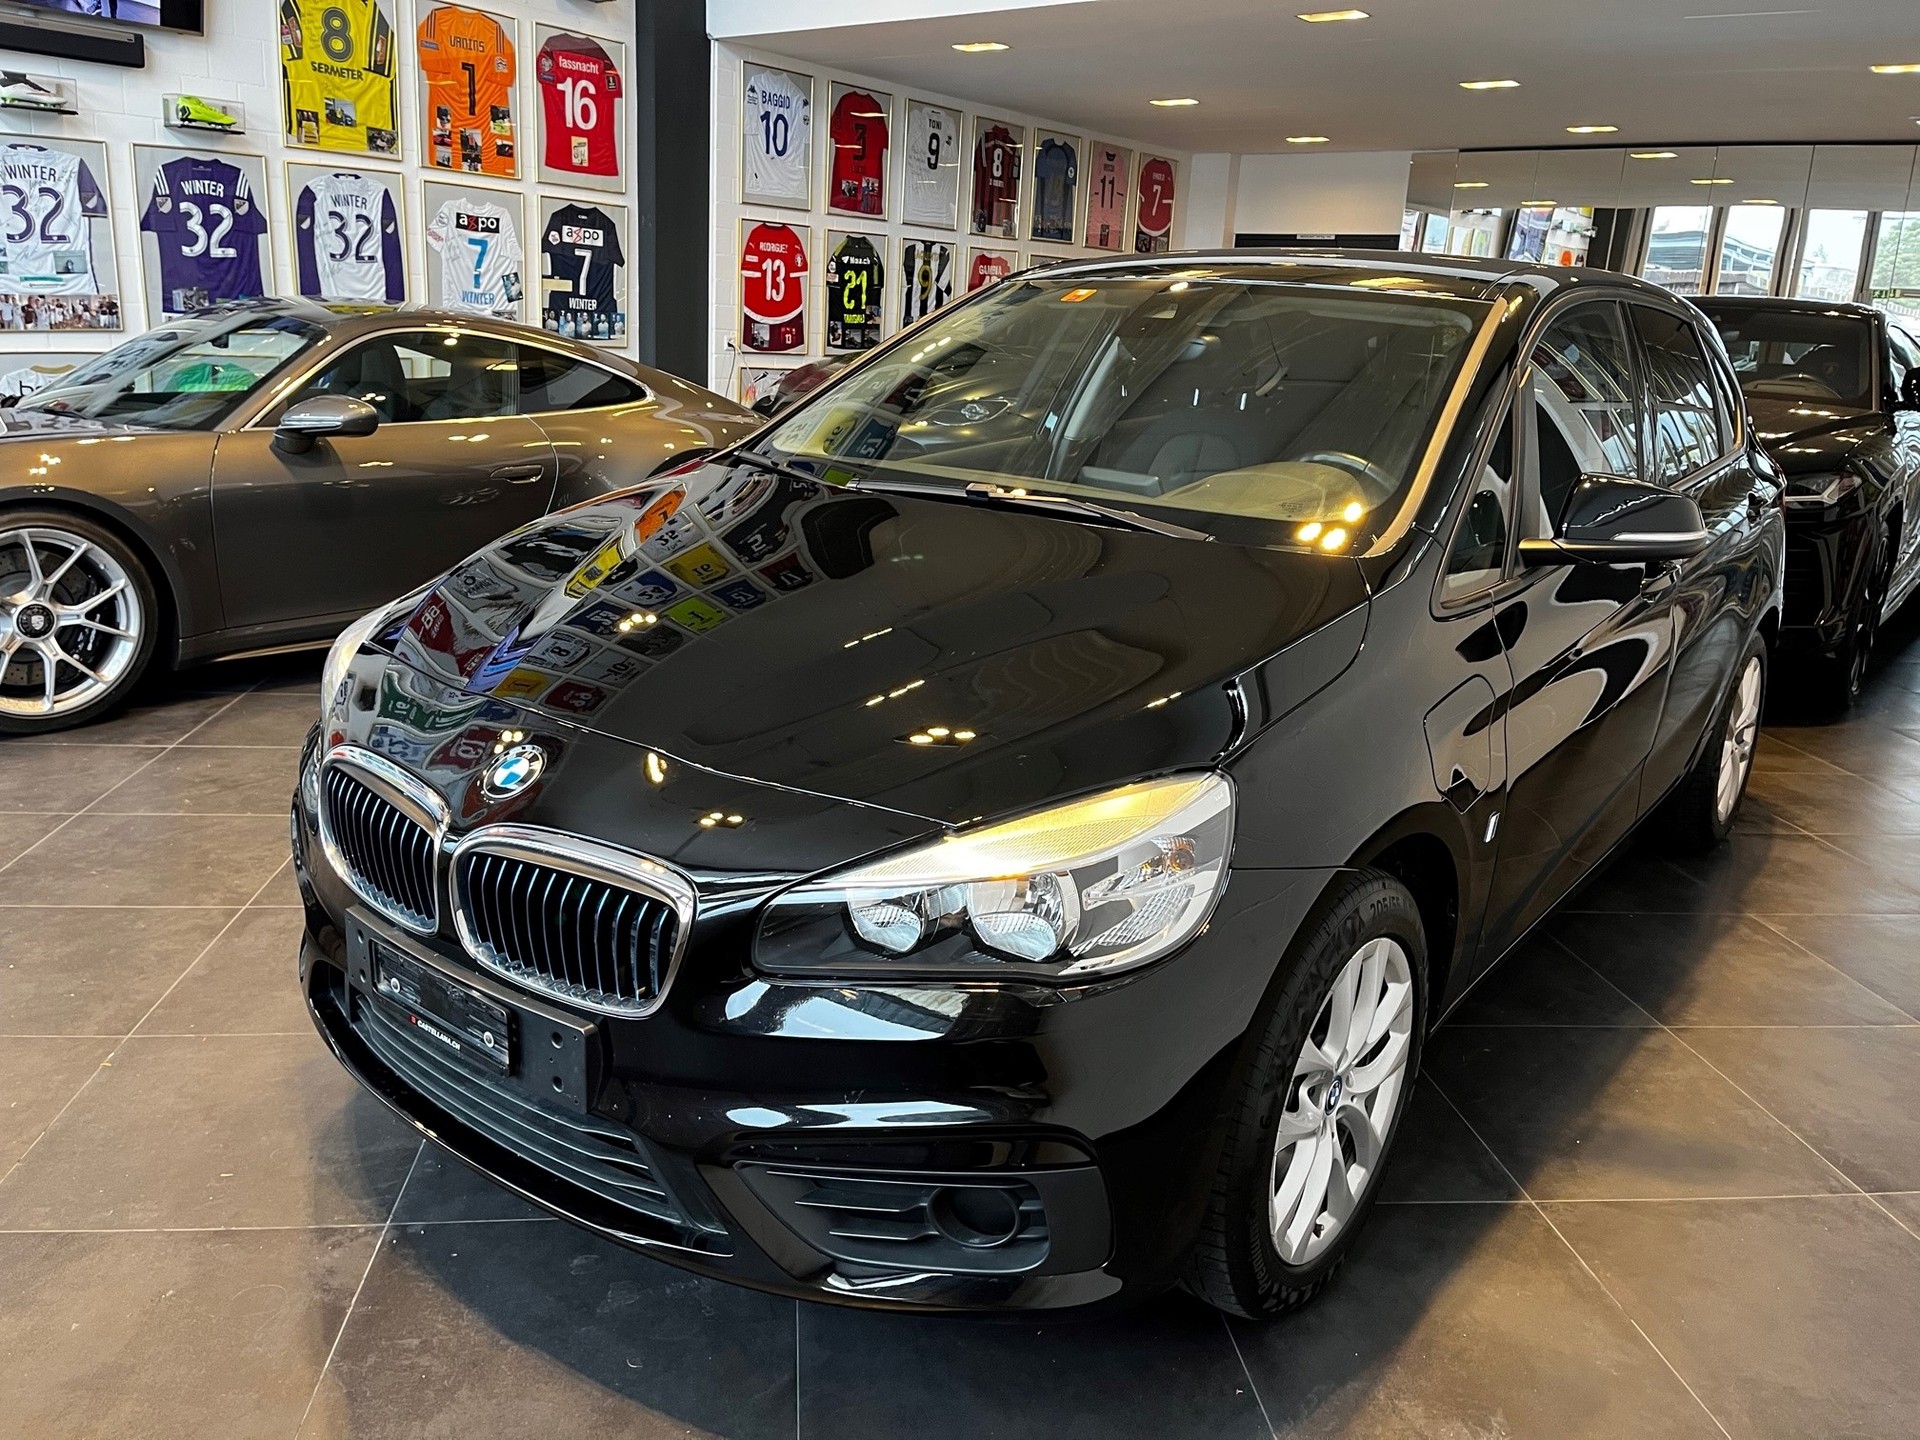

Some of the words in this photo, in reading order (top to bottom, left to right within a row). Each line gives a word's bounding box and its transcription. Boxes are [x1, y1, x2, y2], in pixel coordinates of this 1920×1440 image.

[321, 7, 354, 62] 8
[310, 61, 364, 81] SERMETER
[558, 56, 600, 74] fassnacht
[461, 62, 476, 116] 1
[556, 77, 598, 130] 16
[761, 90, 791, 109] BAGGIO
[760, 110, 789, 157] 10
[928, 118, 942, 130] TONI
[927, 132, 940, 170] 9
[992, 147, 1003, 178] 8
[4, 164, 57, 182] WINTER
[181, 179, 225, 198] WINTER
[330, 194, 368, 210] WINTER
[1100, 175, 1115, 209] 11
[1152, 184, 1162, 216] 7
[1, 184, 71, 244] 32
[179, 201, 238, 258] 32
[328, 210, 378, 263] 32
[468, 237, 488, 289] 7
[574, 248, 592, 296] 7
[762, 258, 786, 302] 13
[461, 290, 495, 305] WINTER
[843, 270, 867, 310] 21
[918, 264, 932, 300] 9
[568, 297, 598, 311] WINTER
[417, 1019, 461, 1051] CASTELLANA.CH
